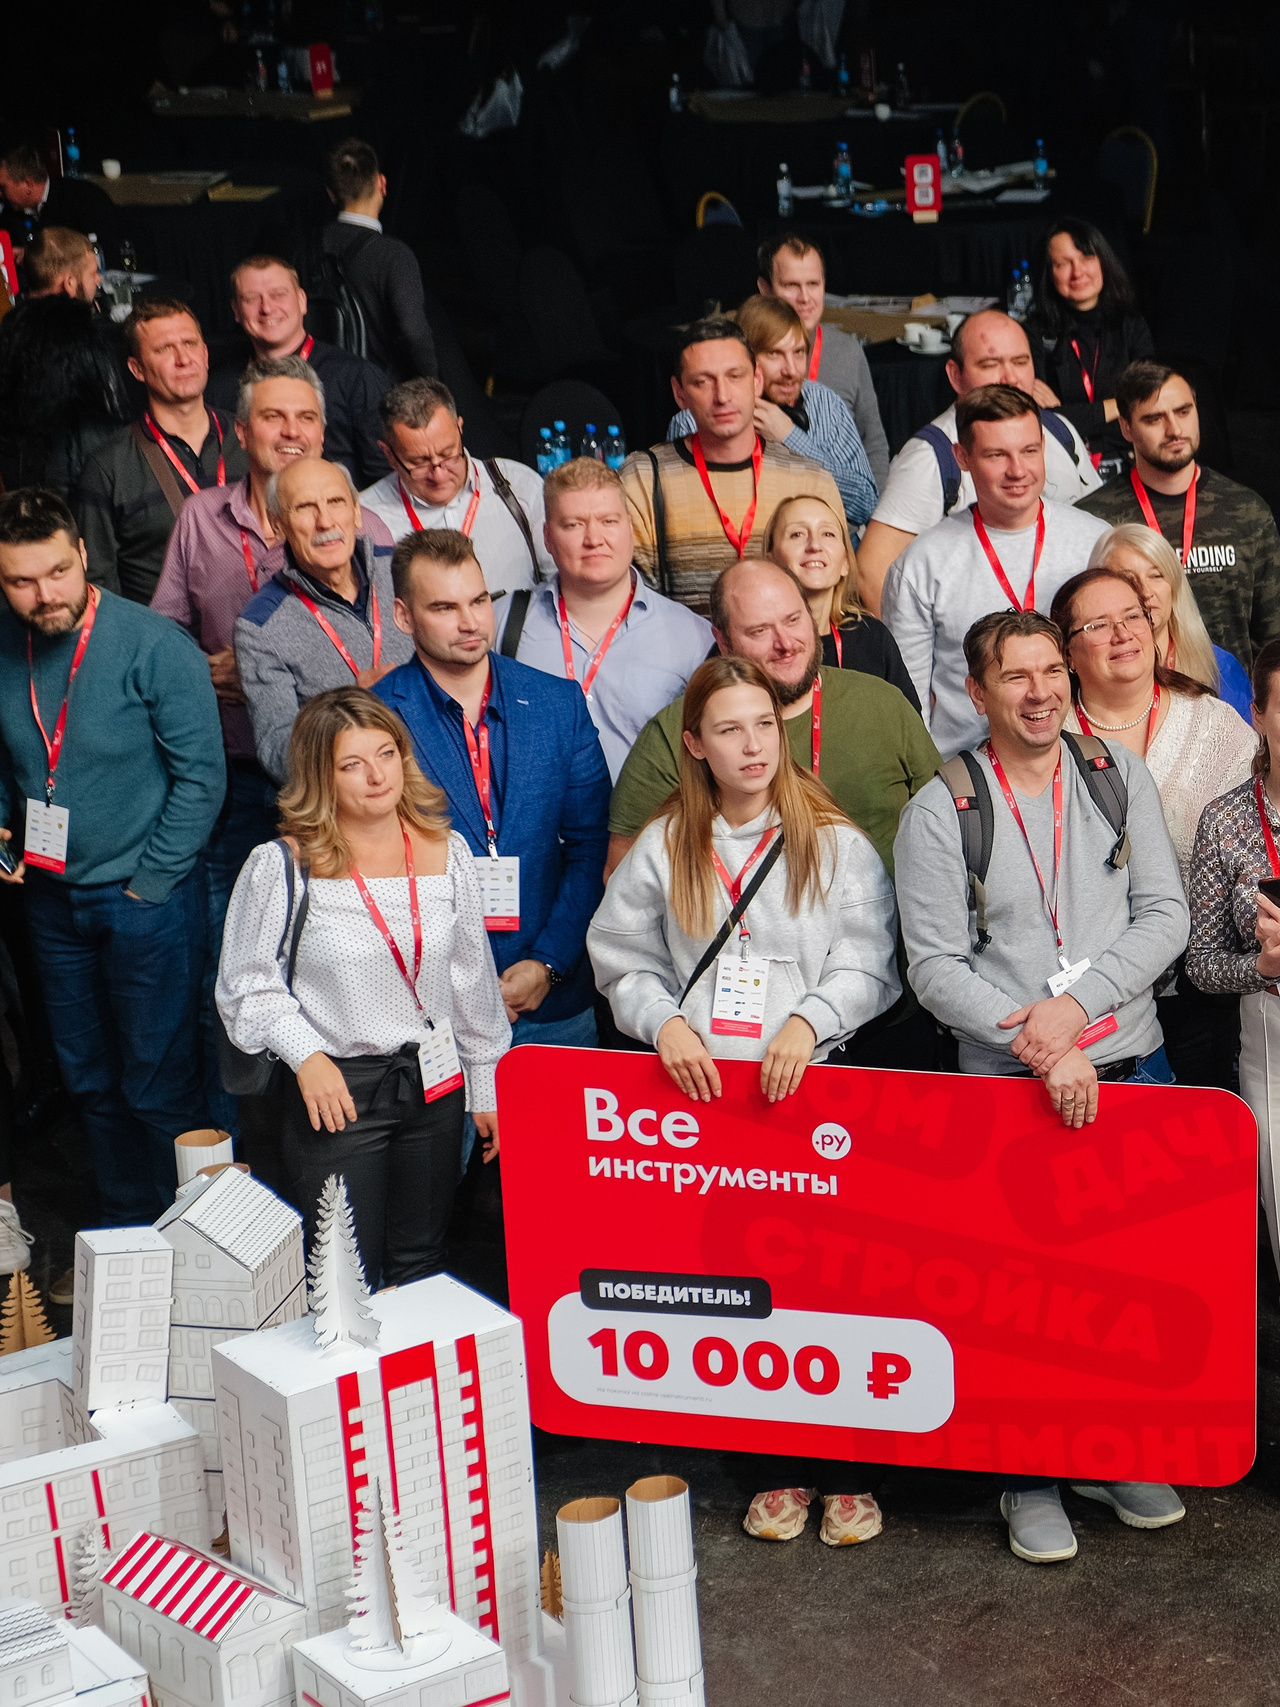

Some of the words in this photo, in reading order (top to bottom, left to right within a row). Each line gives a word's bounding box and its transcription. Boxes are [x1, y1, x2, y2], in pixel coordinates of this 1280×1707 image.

[583, 1087, 700, 1149] Все
[815, 1133, 847, 1152] .ру
[588, 1155, 838, 1195] инструменты
[1050, 1104, 1255, 1227] ДАЧ
[598, 1282, 751, 1306] ПОБЕДИТЕЛЬ!
[744, 1217, 1160, 1363] СТРОЙКА
[586, 1327, 670, 1382] 10
[692, 1336, 841, 1396] 000
